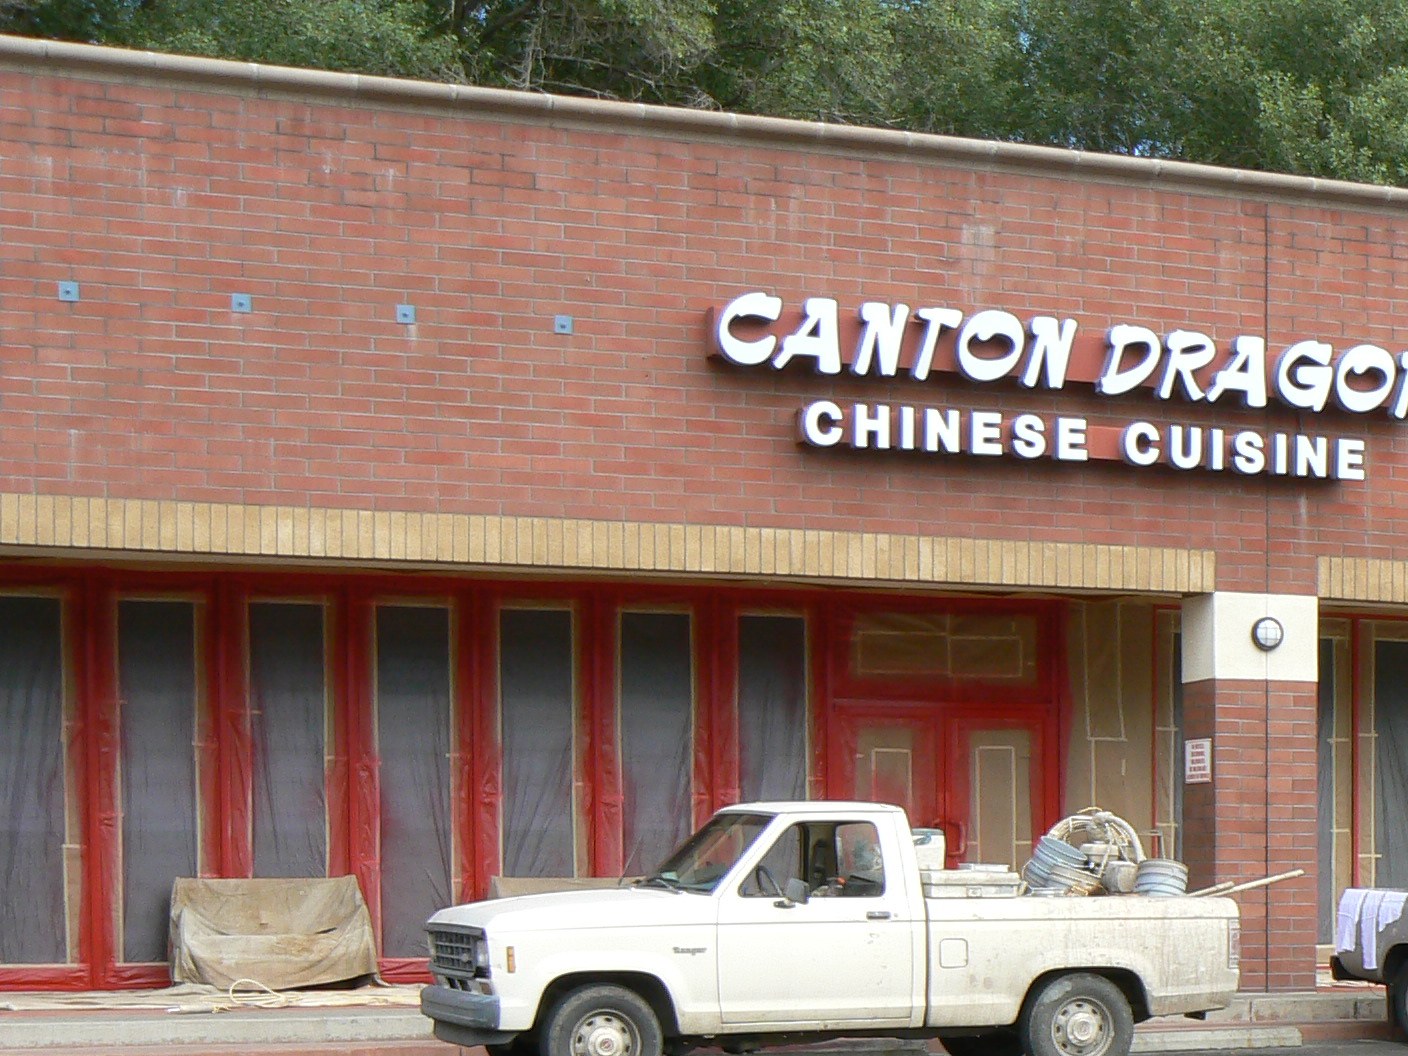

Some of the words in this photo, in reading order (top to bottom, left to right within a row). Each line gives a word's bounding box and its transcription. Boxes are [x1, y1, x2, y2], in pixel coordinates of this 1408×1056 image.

[716, 291, 1078, 391] CANTON
[803, 400, 1089, 461] CHINESE
[1122, 421, 1366, 481] CUISINE
